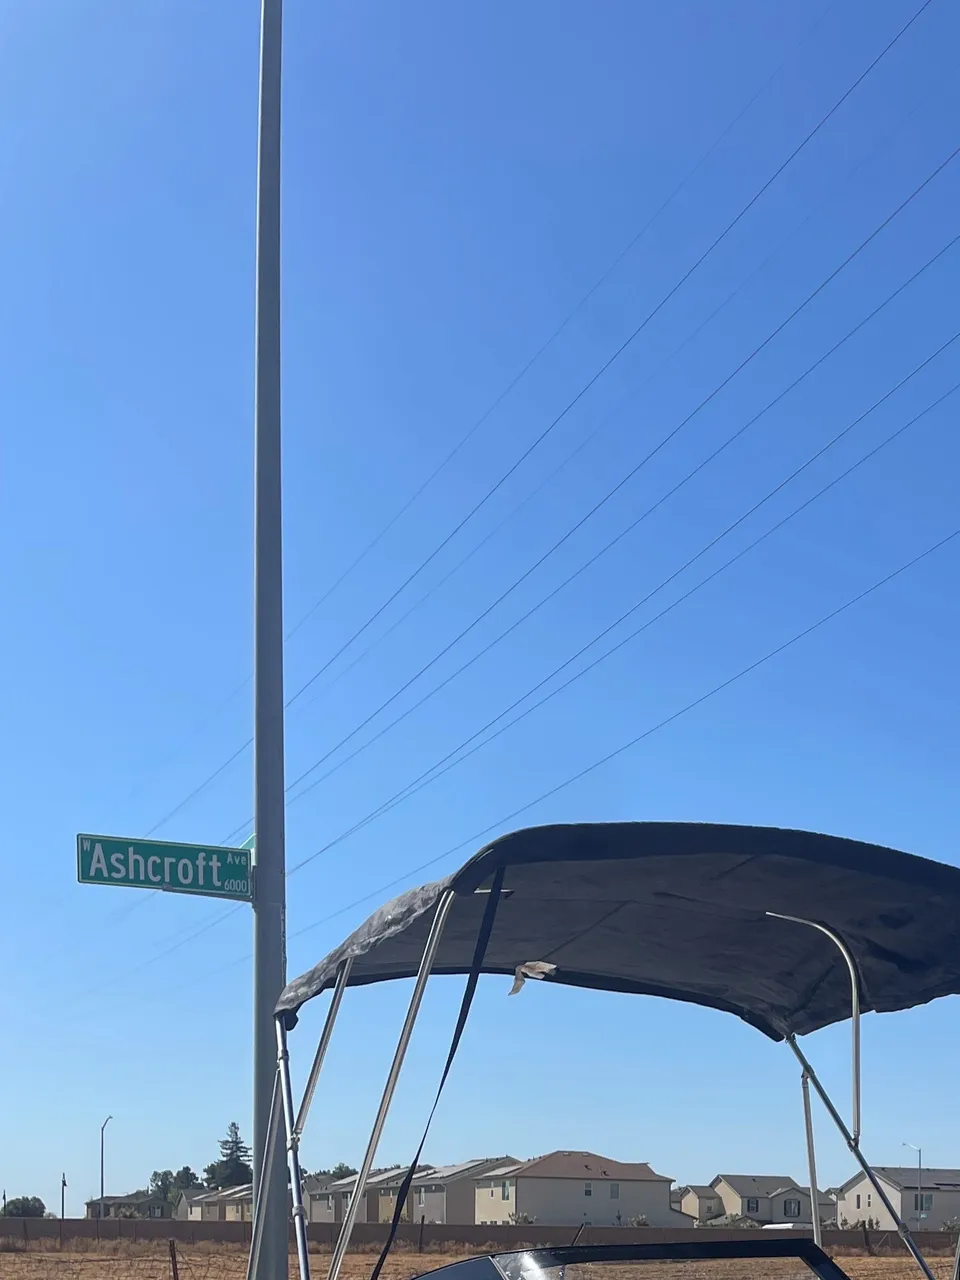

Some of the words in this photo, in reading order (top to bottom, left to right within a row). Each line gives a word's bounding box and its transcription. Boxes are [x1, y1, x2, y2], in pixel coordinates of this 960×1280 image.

[82, 838, 92, 852] W
[89, 842, 222, 887] Ashcroft
[226, 852, 247, 866] Ave
[224, 878, 247, 892] 6000
